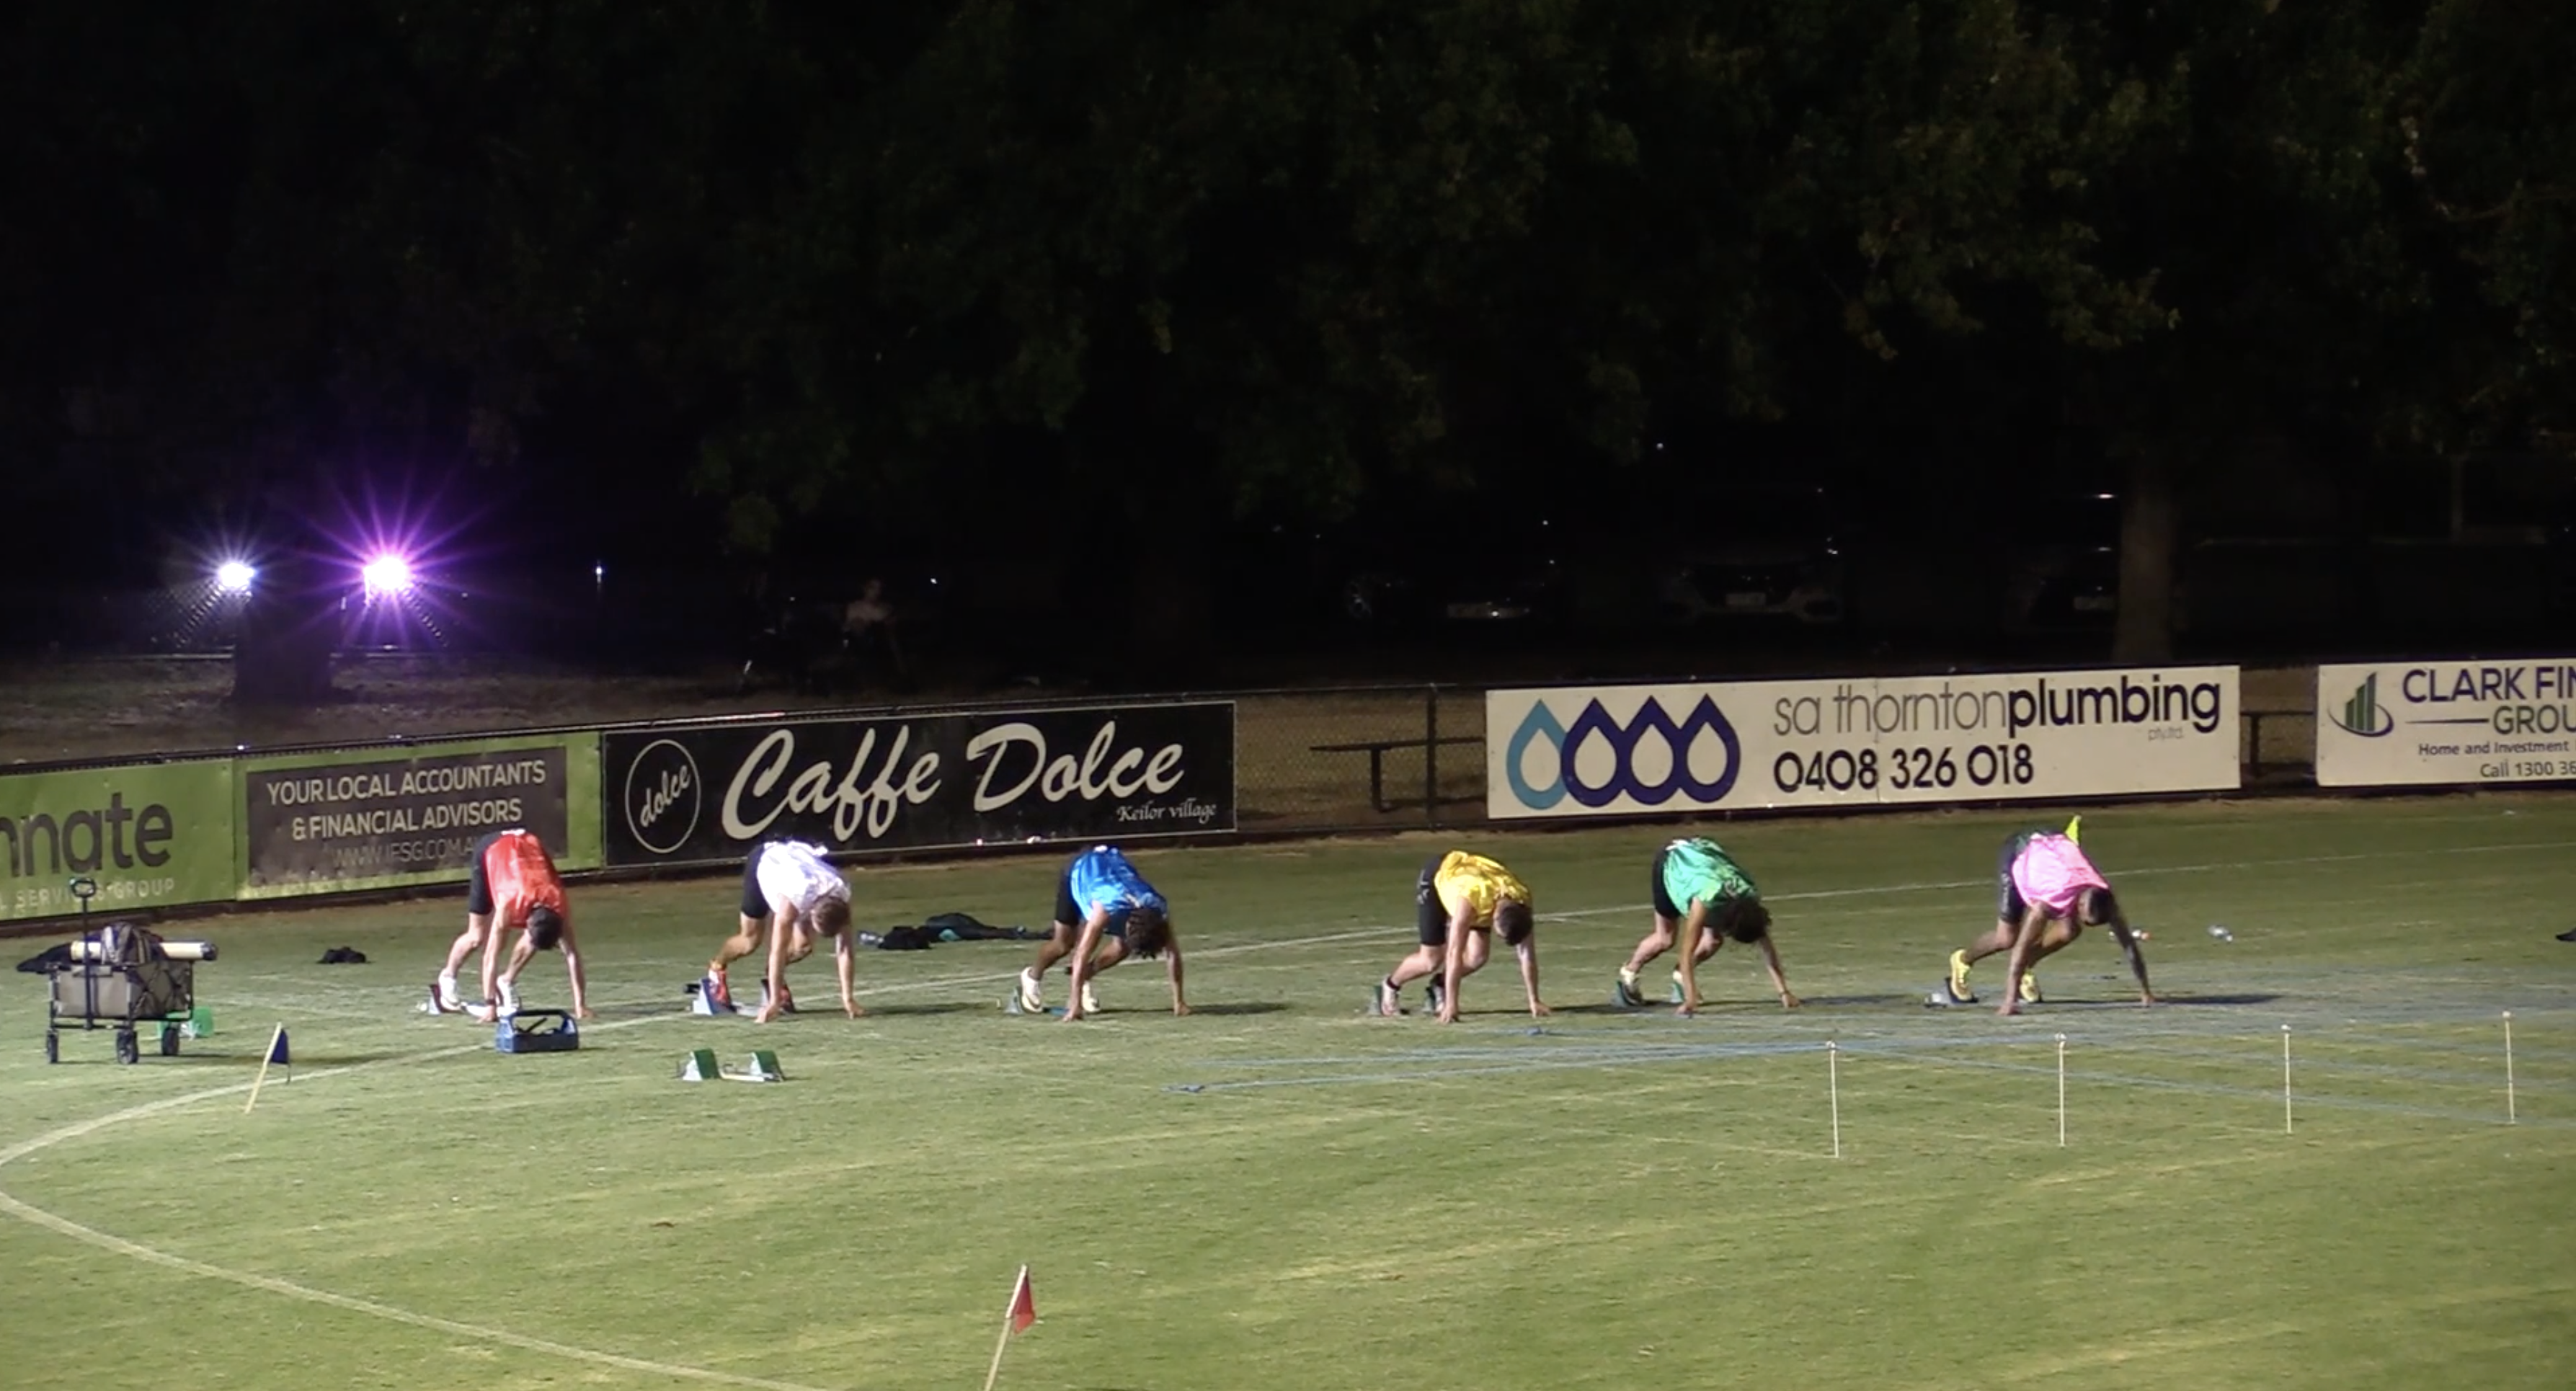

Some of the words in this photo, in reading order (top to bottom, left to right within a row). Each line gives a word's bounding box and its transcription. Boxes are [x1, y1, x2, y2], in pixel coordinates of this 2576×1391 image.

[2402, 667, 2526, 703] CLARK
[1774, 697, 1821, 736] sa
[2418, 744, 2461, 755] Home
[2464, 742, 2490, 755] and
[2494, 740, 2570, 754] Investment
[267, 778, 324, 806] YOUR
[327, 773, 398, 801] LOCAL
[399, 760, 546, 796] ACCOUNTANTS
[722, 729, 941, 841] Caffe
[967, 721, 1184, 812] Dolce
[1774, 748, 1878, 794] 0408
[1890, 747, 1957, 789] 326
[1966, 743, 2034, 786] 018
[2480, 759, 2510, 778] Call
[2515, 761, 2554, 777] 1300
[640, 765, 691, 827] dolce
[1116, 800, 1165, 822] Keilor
[1168, 797, 1217, 825] village
[292, 817, 306, 841] &
[309, 808, 419, 839] FINANCIAL
[422, 797, 523, 830] ADVISORS
[112, 878, 175, 900] GROUP
